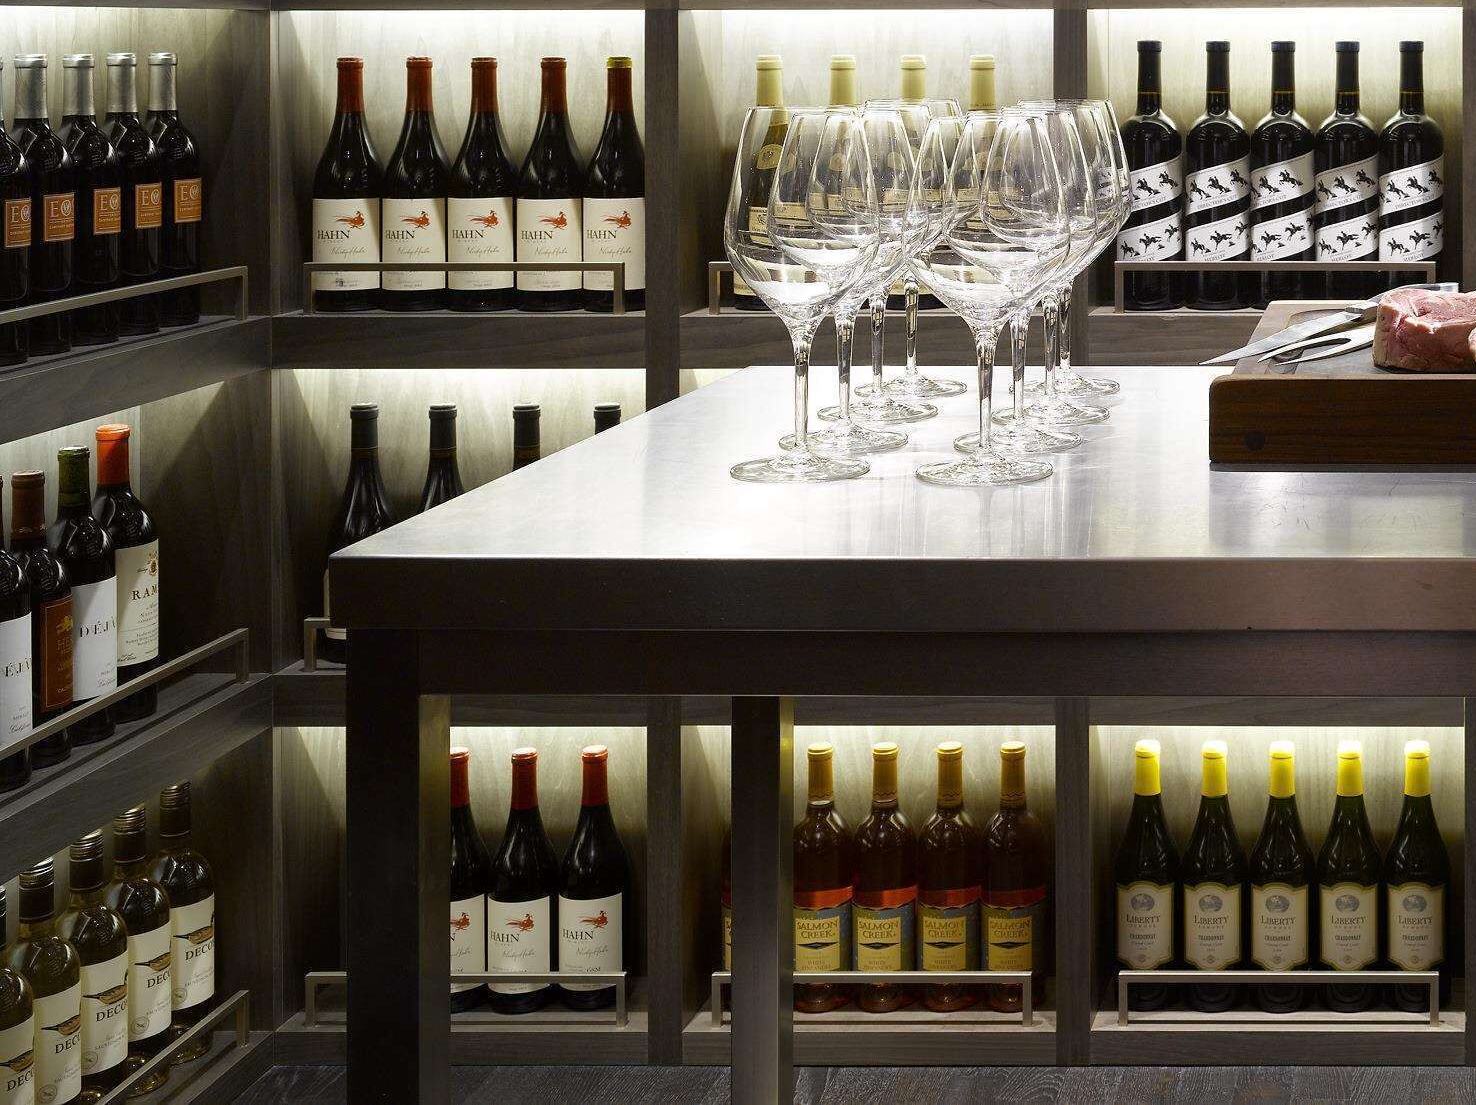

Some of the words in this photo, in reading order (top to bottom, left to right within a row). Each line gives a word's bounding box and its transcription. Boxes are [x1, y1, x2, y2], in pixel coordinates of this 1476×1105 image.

[317, 230, 350, 240] HAHN
[385, 230, 415, 240] HAHN
[452, 229, 484, 240] HAHN
[521, 230, 553, 241] HAHN
[586, 229, 617, 240] HAHN
[1126, 914, 1160, 925] LIBERTY
[1193, 914, 1229, 925] LIBERTY
[1261, 915, 1296, 926] LIBERTY
[1331, 915, 1366, 925] LIBERTY
[1398, 915, 1433, 926] LIBERTY
[796, 920, 838, 931] SALMON
[858, 920, 898, 931] SALMON
[925, 920, 964, 931] SALMON
[991, 920, 1030, 931] SALMON
[490, 930, 520, 943] HAHN
[562, 928, 594, 940] HAHN
[801, 930, 832, 940] CREEK
[862, 930, 893, 940] CREEK
[928, 930, 957, 940] CREEK
[995, 930, 1024, 939] CREEK
[185, 943, 214, 961] DECO
[147, 972, 171, 988] DECO
[96, 1002, 127, 1022] DECO
[55, 1032, 80, 1054] DECO
[6, 1069, 34, 1091] DECO
